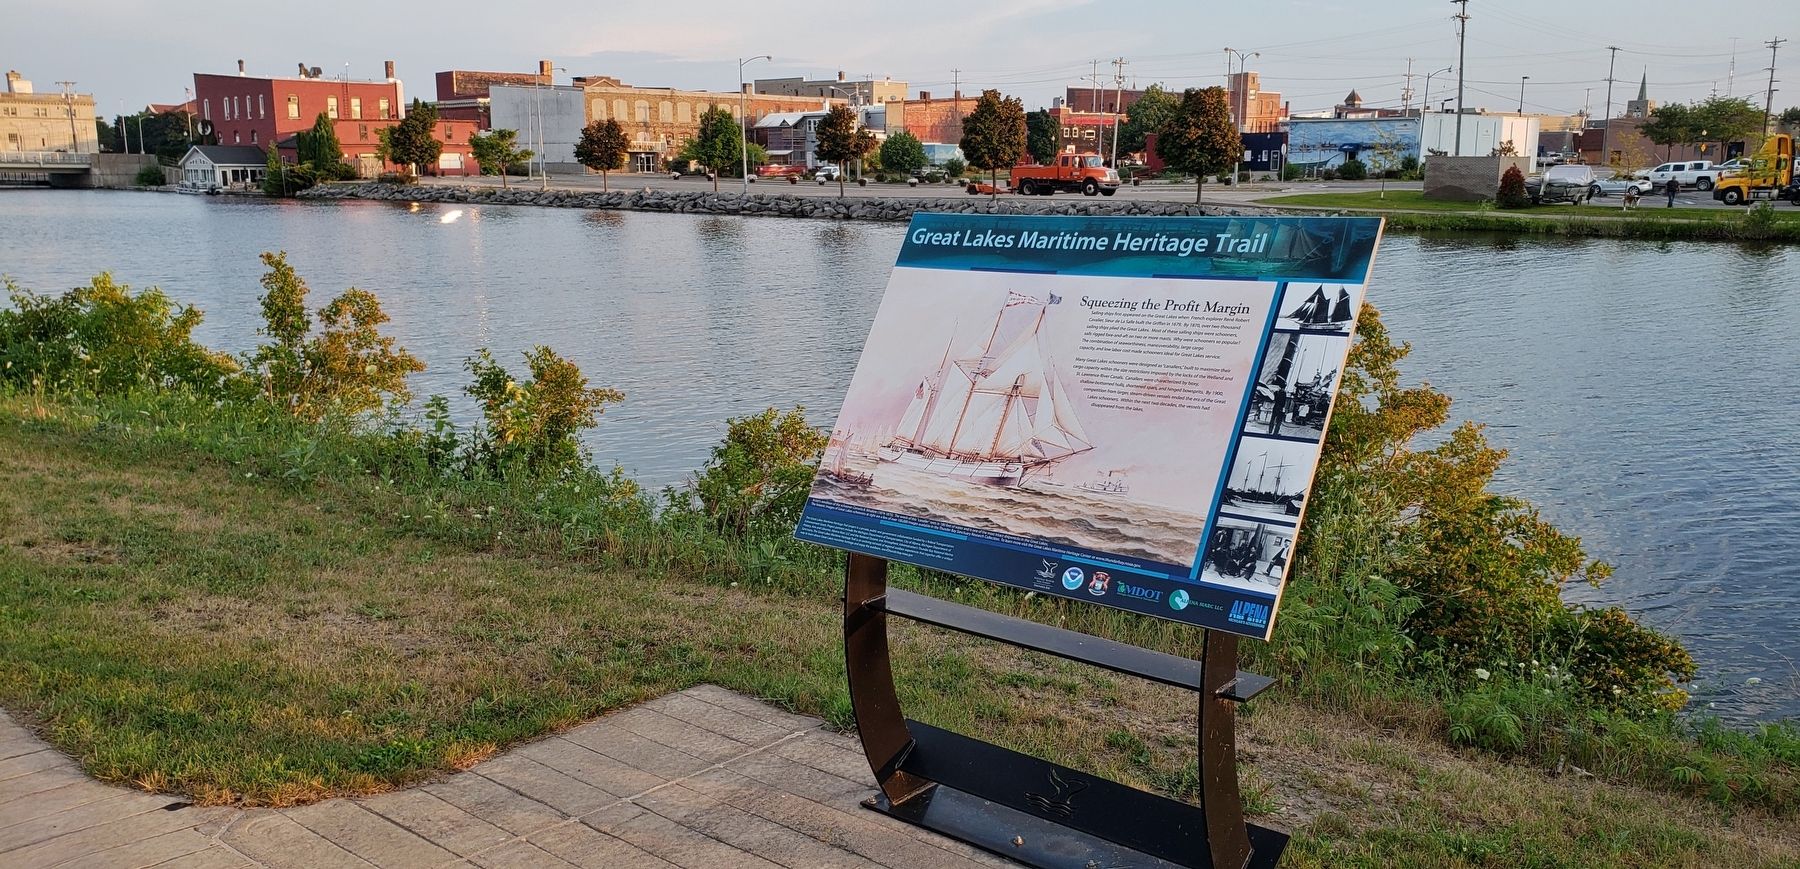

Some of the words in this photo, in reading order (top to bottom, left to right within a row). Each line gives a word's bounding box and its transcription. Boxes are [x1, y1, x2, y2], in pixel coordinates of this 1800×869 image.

[912, 228, 961, 246] Great
[963, 229, 1016, 248] Lakes
[1017, 231, 1109, 251] Maritime
[1112, 232, 1208, 258] Heritage
[1215, 233, 1268, 253] Trail
[1080, 295, 1139, 311] Squeezing
[1141, 298, 1160, 310] the
[1163, 299, 1200, 312] Profit
[1203, 301, 1250, 316] Margin
[1117, 584, 1163, 600] MDOT
[1230, 600, 1269, 620] ALPENA
